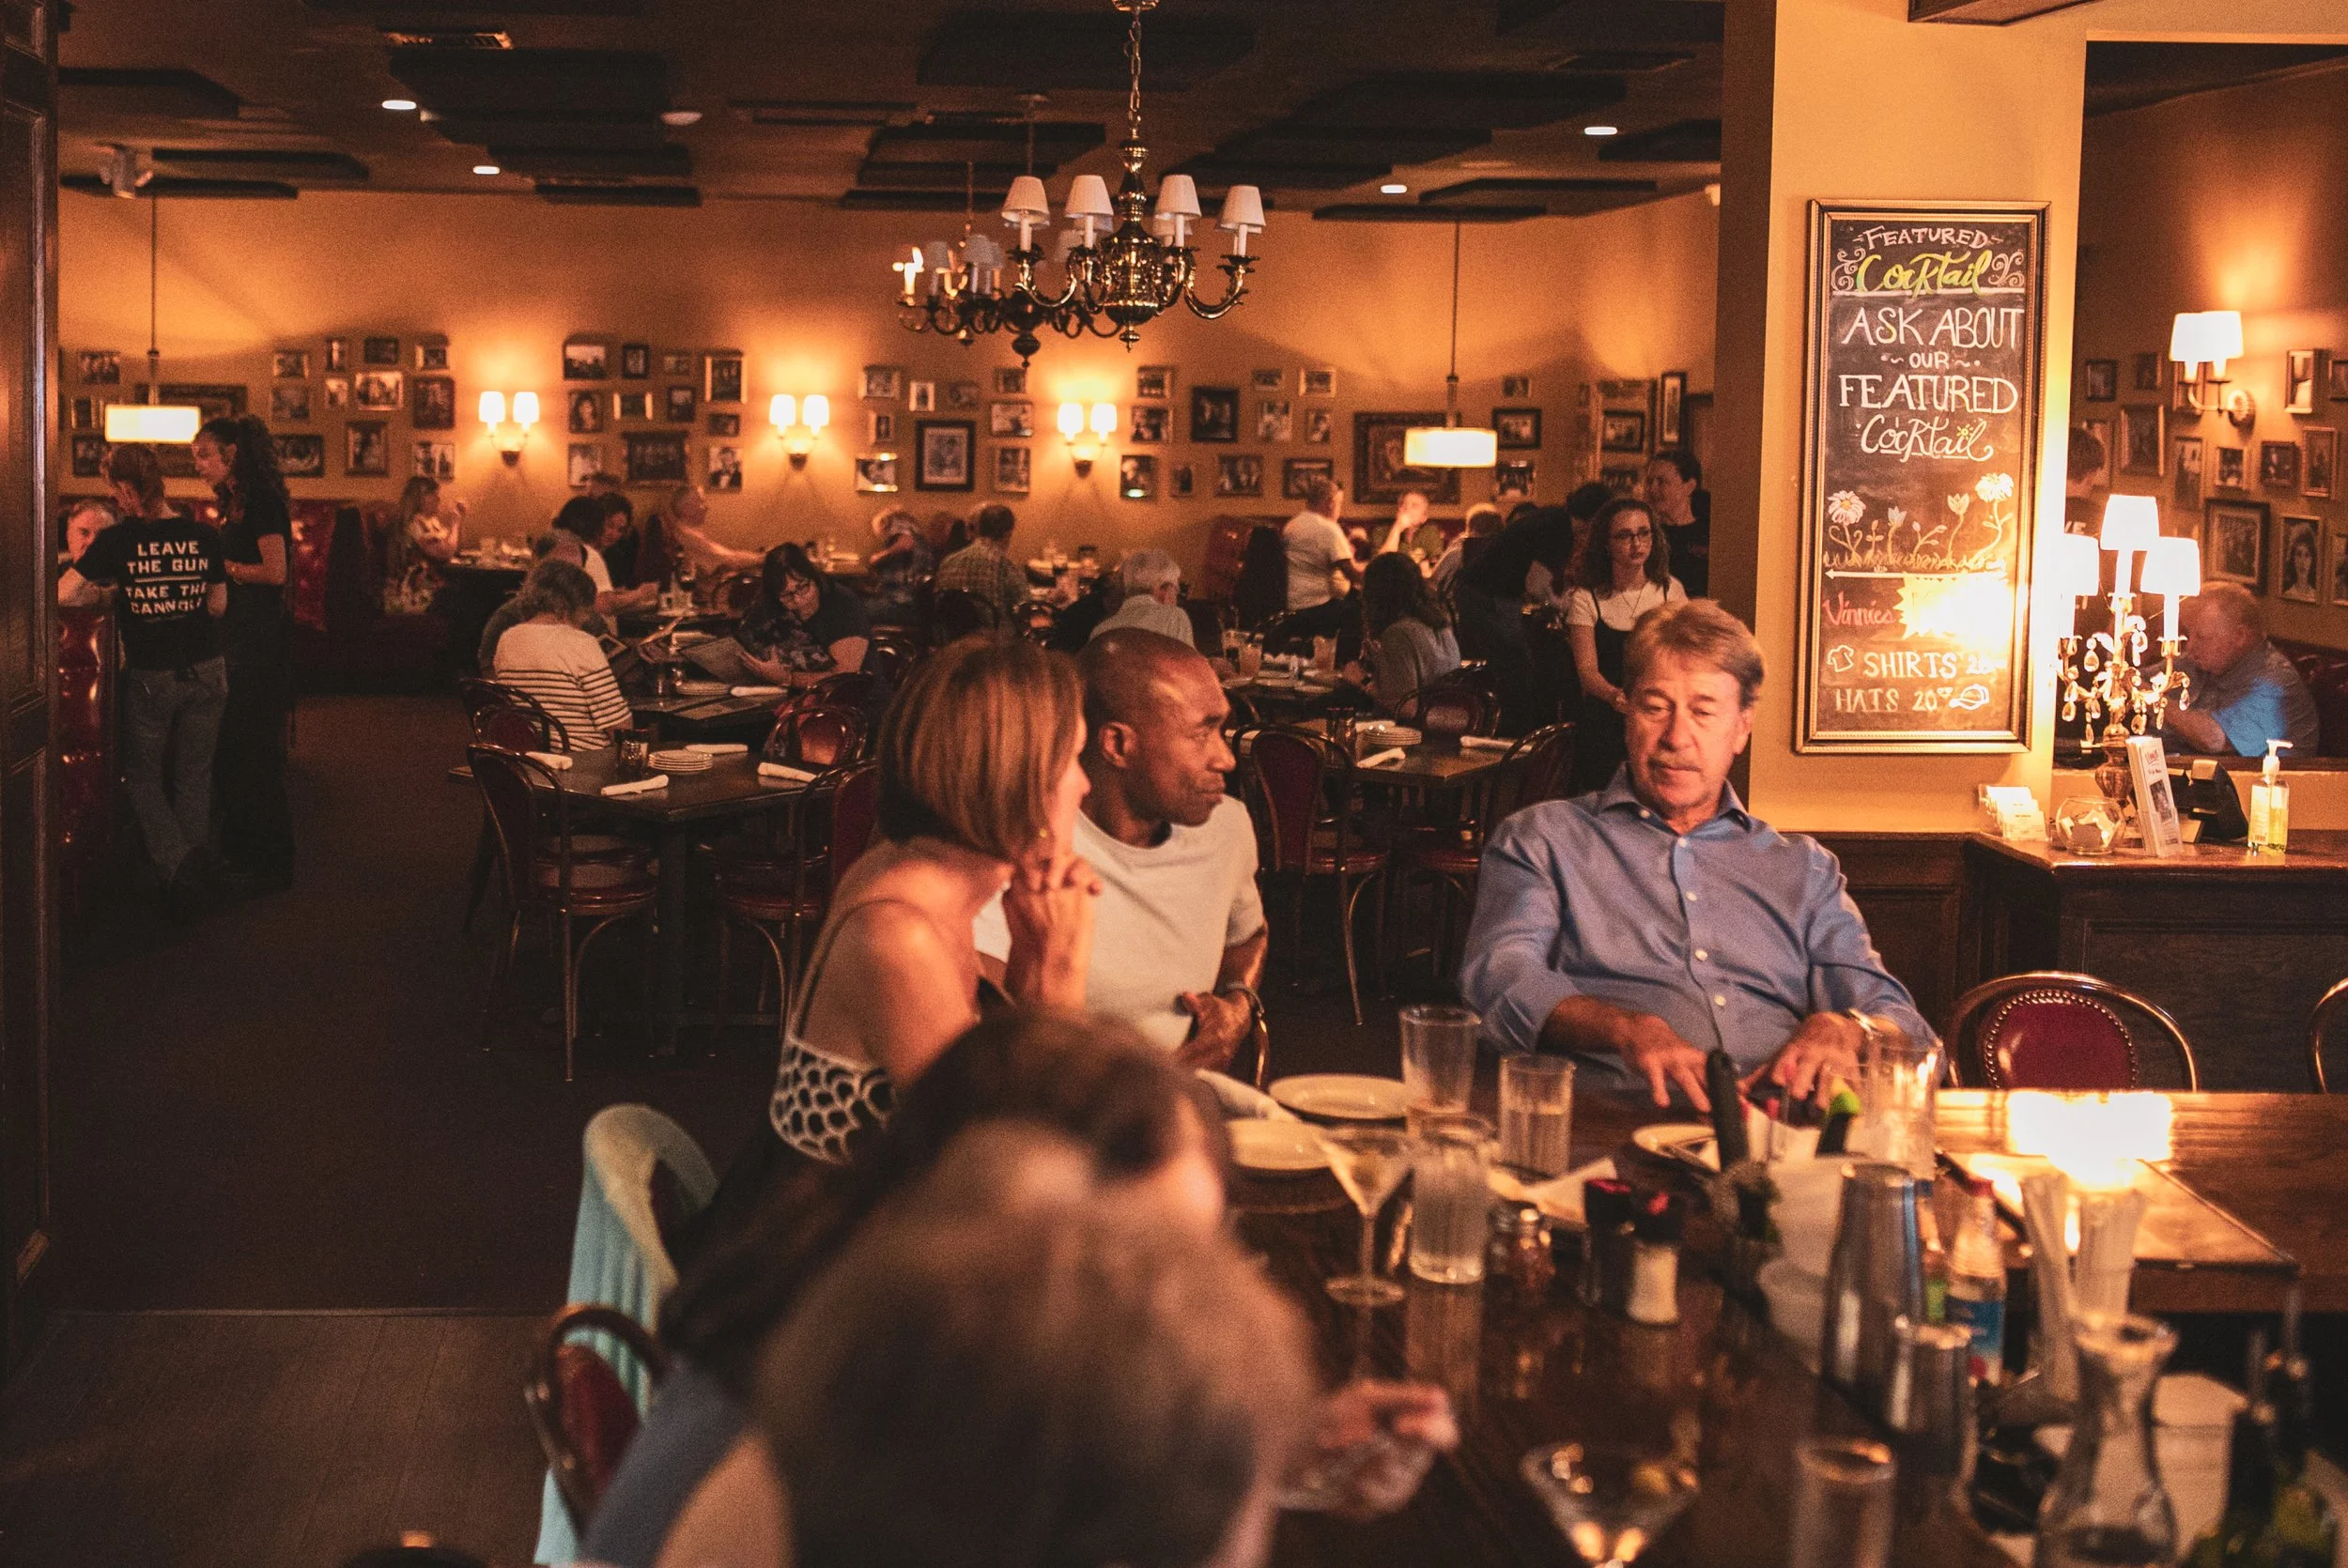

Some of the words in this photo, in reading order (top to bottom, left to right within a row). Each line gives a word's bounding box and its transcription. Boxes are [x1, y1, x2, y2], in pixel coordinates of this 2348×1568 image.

[1863, 225, 1988, 250] FEATURED
[1841, 307, 1924, 346] ASK
[1928, 307, 2024, 348] ABOUT
[1908, 351, 1950, 370] OUR
[1838, 374, 2018, 414] FEATURED
[137, 540, 199, 557] LEAVE
[127, 559, 162, 575] THE
[172, 558, 209, 573] GUN
[125, 584, 169, 599] TAKE
[1862, 651, 1958, 679] SHIRTS
[1835, 687, 1899, 713] HATS
